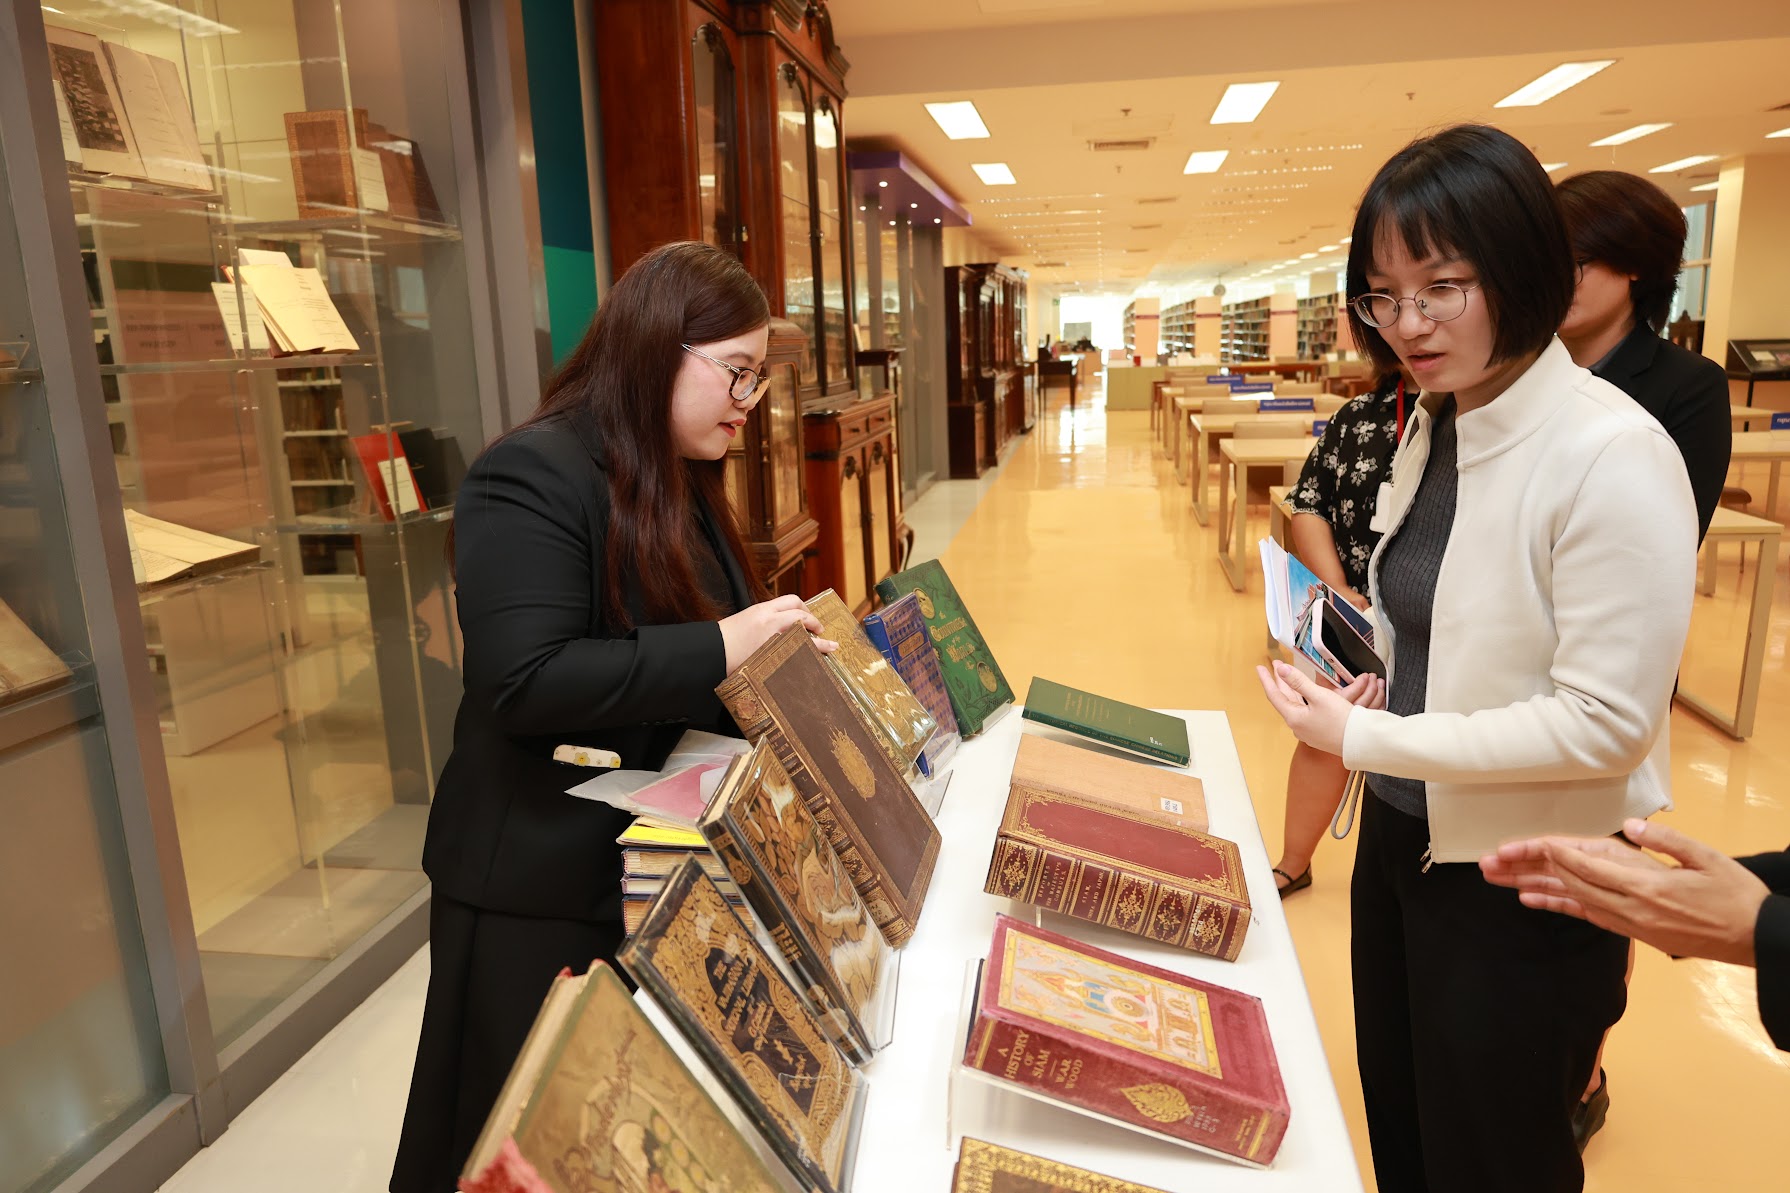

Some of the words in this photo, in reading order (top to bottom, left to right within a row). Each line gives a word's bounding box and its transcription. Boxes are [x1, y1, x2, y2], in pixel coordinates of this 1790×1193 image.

[1037, 864, 1050, 897] REPORTS
[1091, 890, 1099, 903] AND
[996, 1044, 1009, 1058] A
[1003, 1028, 1030, 1080] HISTORY
[1022, 1051, 1035, 1067] OF
[1030, 1048, 1051, 1079] SIAM
[1064, 1057, 1083, 1090] WOOD
